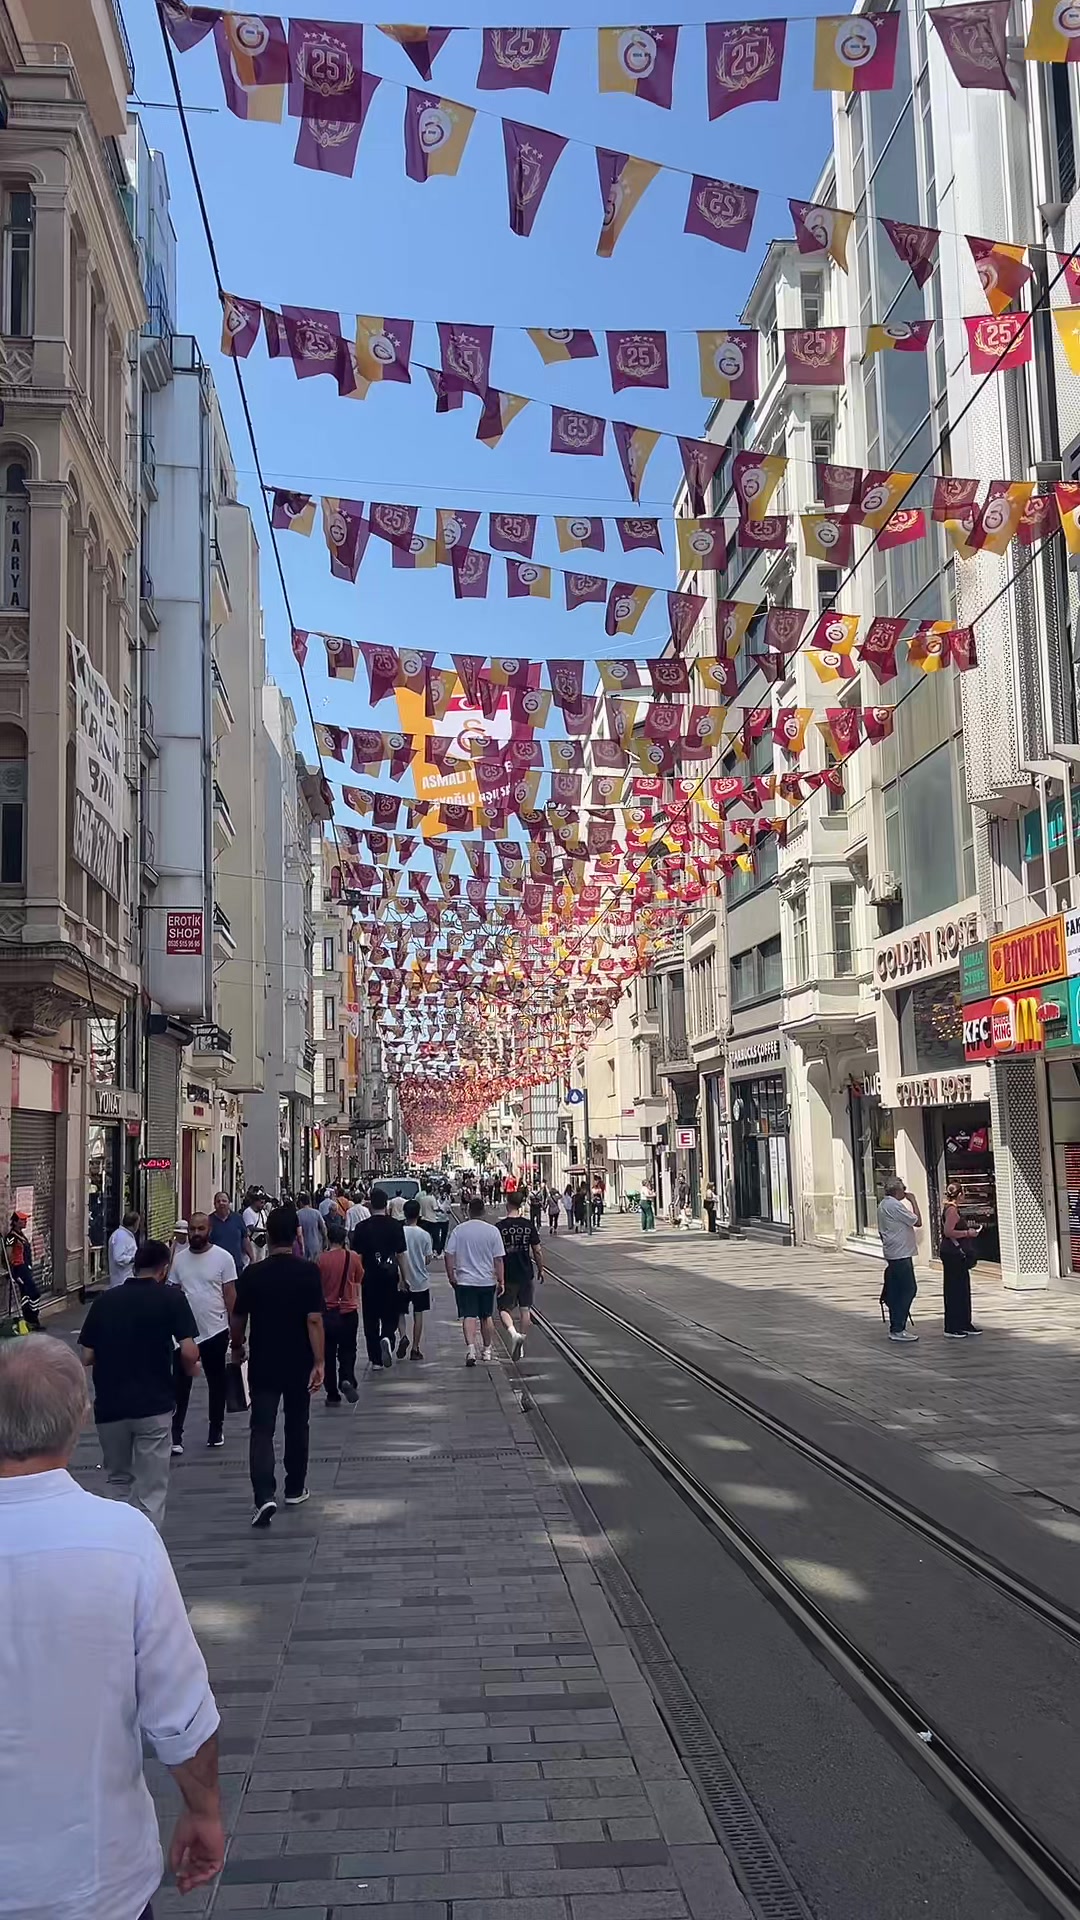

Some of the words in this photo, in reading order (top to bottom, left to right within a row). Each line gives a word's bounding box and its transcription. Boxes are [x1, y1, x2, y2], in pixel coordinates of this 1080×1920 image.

[505, 28, 536, 56] 25
[311, 49, 340, 80] 25
[731, 42, 760, 76] 25
[305, 331, 330, 351] 25
[804, 331, 827, 355] 25
[986, 323, 1012, 347] 25
[627, 348, 650, 367] 25
[384, 508, 402, 529] 25
[503, 518, 522, 537] 25
[633, 520, 652, 533] 25
[754, 520, 773, 535] 25
[10, 520, 20, 606] KARYA
[375, 654, 393, 671] 25
[662, 668, 677, 680] 25
[518, 742, 533, 755] 25
[422, 770, 466, 790] ASMALI
[168, 914, 201, 927] EROTİK
[169, 928, 200, 939] SHOP
[877, 931, 933, 979] GOLDEN
[935, 911, 980, 959] ROSE
[1003, 926, 1061, 984] BOWLING
[962, 1016, 989, 1044] KFC
[993, 1023, 1012, 1041] KING
[729, 1045, 757, 1061] STARBUCKS
[757, 1040, 778, 1057] COFFEE
[896, 1077, 938, 1100] GOLDEN
[941, 1073, 972, 1097] ROSE
[681, 1133, 691, 1144] E
[502, 1227, 531, 1236] GOOD
[503, 1234, 530, 1246] LIFE
